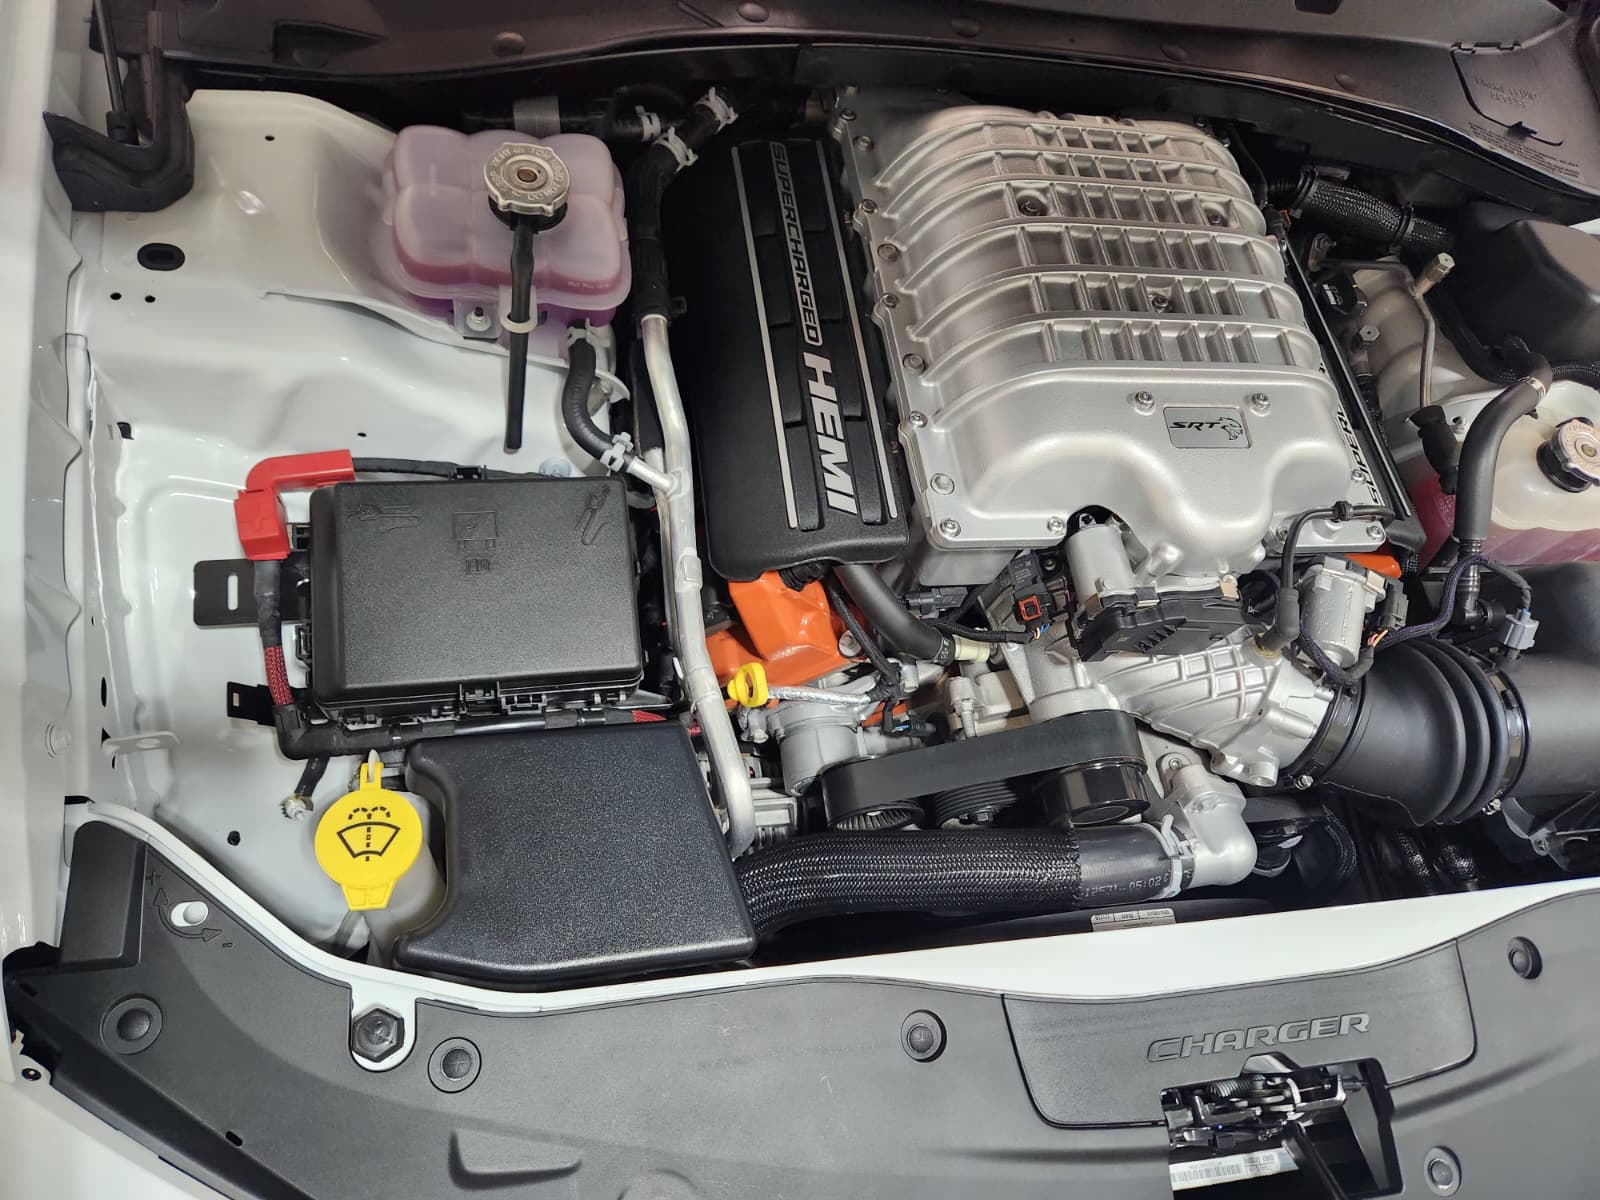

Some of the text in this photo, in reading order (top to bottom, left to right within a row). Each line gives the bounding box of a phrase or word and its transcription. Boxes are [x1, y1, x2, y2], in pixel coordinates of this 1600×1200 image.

[769, 141, 858, 516] SUPERCHARGED HEMI
[1169, 421, 1221, 431] SRT
[1147, 1012, 1370, 1062] CHARGER
